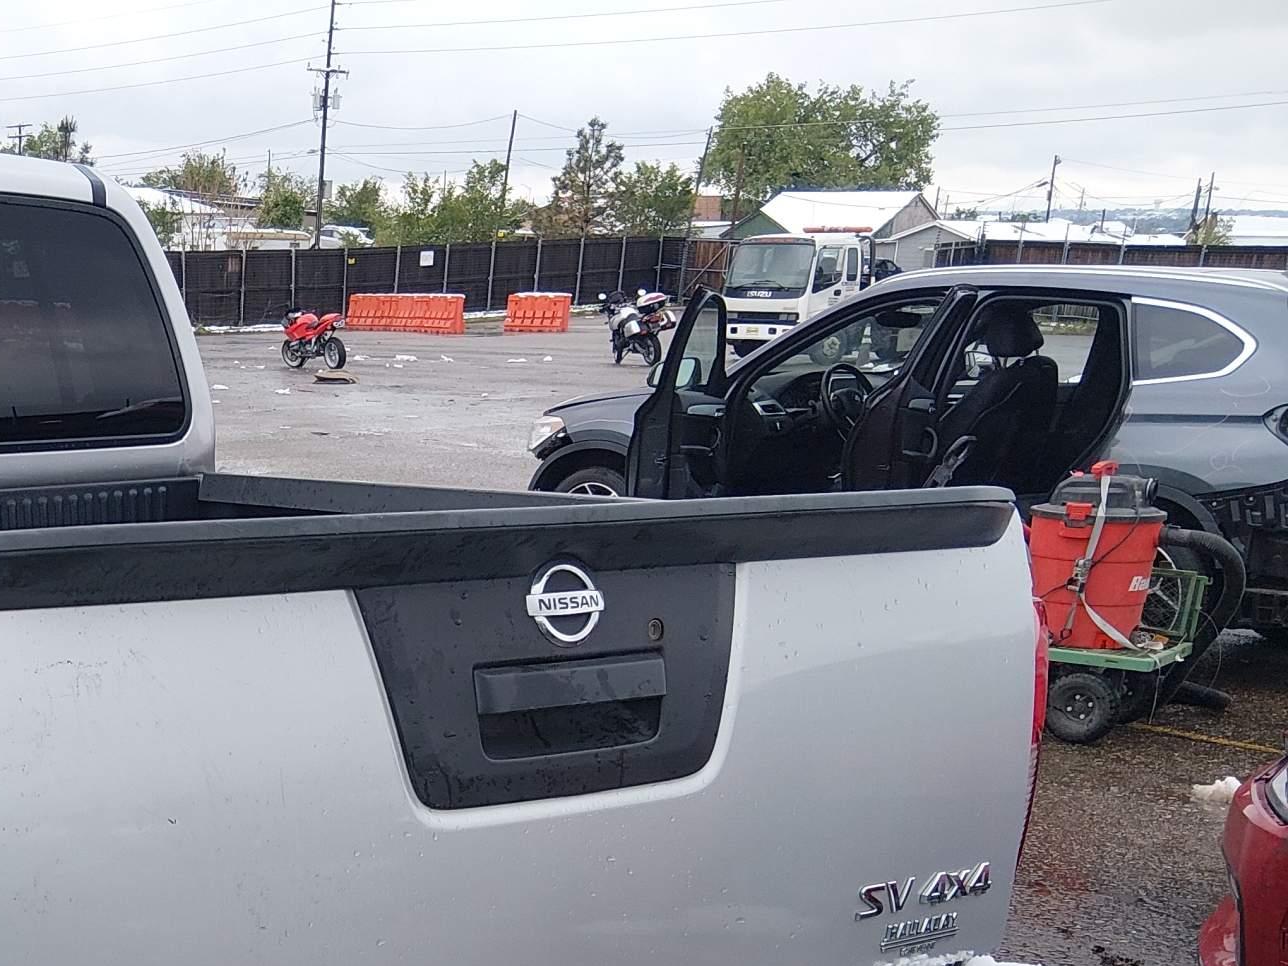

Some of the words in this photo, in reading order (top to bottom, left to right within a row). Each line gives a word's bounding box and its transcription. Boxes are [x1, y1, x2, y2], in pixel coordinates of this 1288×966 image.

[746, 290, 772, 298] ISUZU
[538, 595, 599, 611] NISSAN
[855, 876, 916, 921] SV
